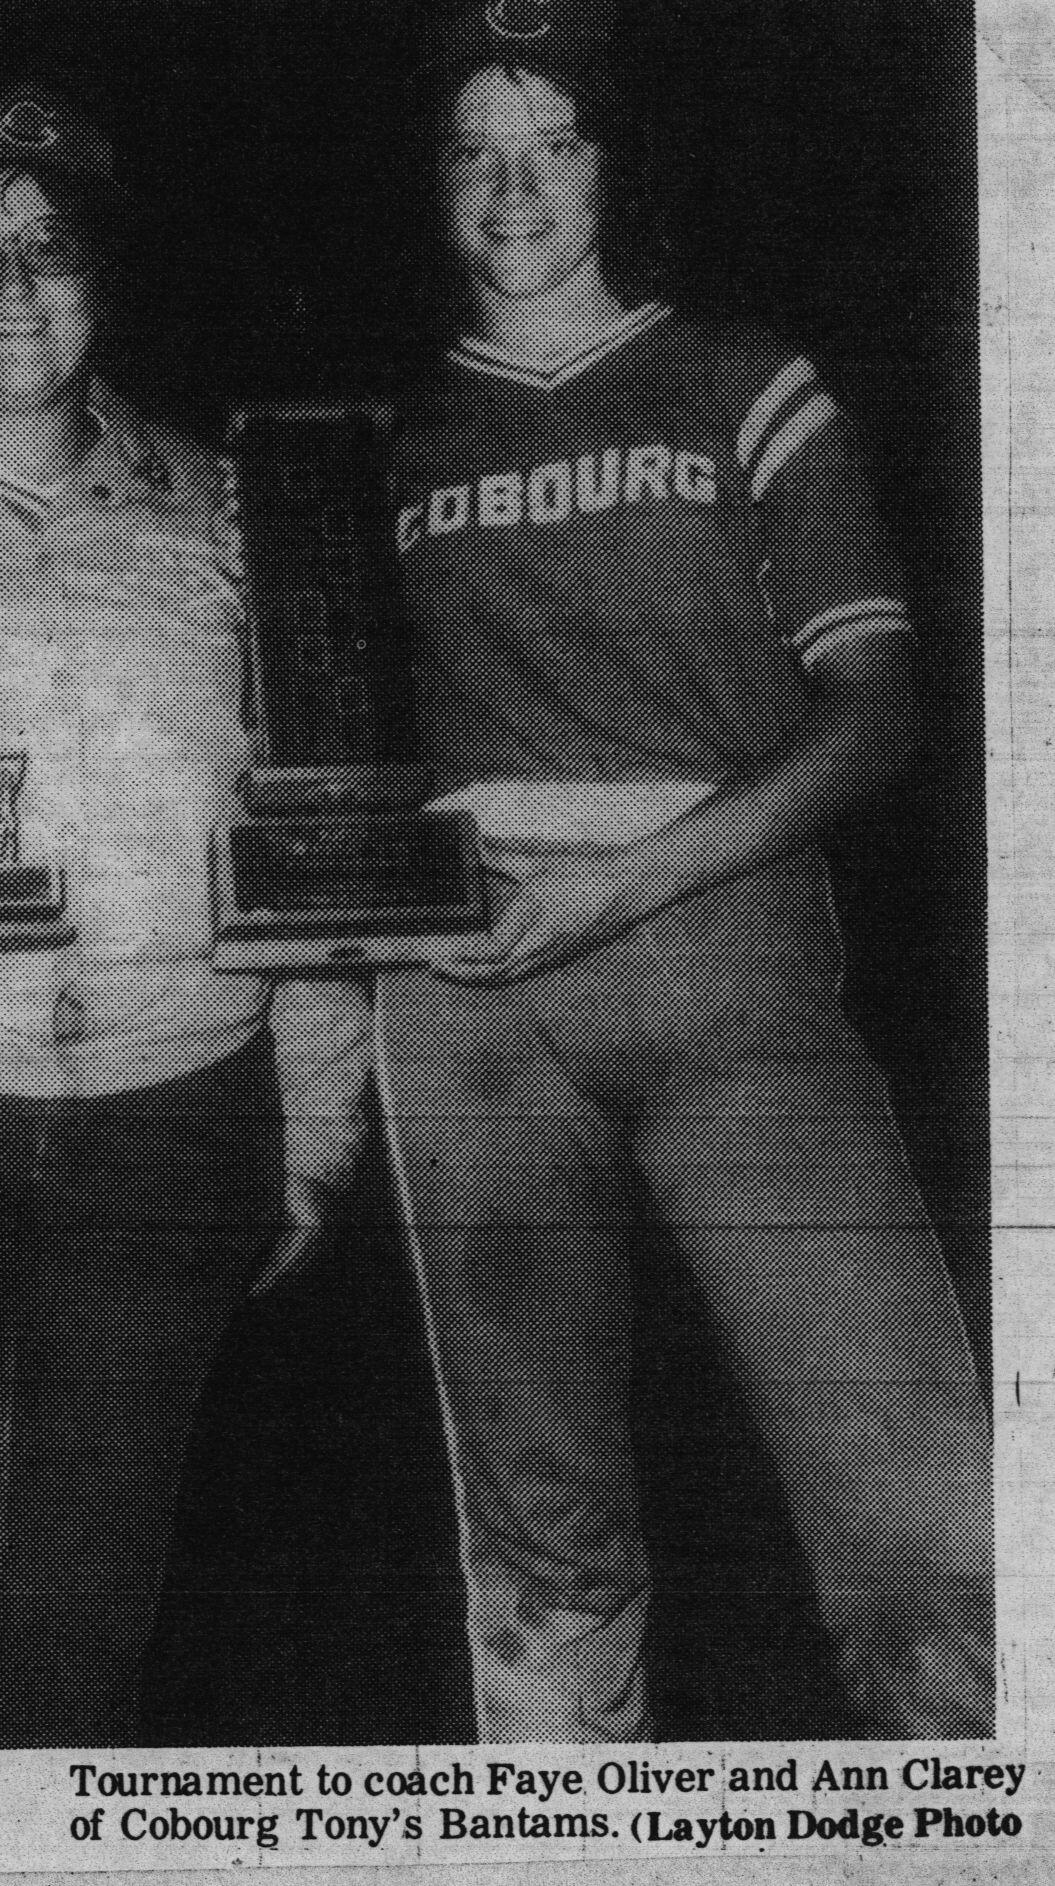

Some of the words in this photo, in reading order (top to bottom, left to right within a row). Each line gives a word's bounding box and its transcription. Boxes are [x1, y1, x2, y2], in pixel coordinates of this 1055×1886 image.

[397, 443, 717, 554] COBOURG
[69, 1764, 304, 1797] Tournament
[316, 1764, 352, 1797] to
[364, 1762, 475, 1797] coach
[486, 1762, 583, 1803] Faye
[597, 1760, 715, 1795] Oliver
[728, 1758, 799, 1792] and
[811, 1759, 889, 1792] Ann
[902, 1757, 1026, 1797] Clarey
[70, 1807, 105, 1841] of
[120, 1807, 279, 1849] Cobourg
[295, 1807, 423, 1848] Tony's
[439, 1806, 619, 1840] Bantams.
[630, 1810, 777, 1849] (Layton
[787, 1808, 904, 1848] Dodge
[913, 1807, 1023, 1838] Photo
